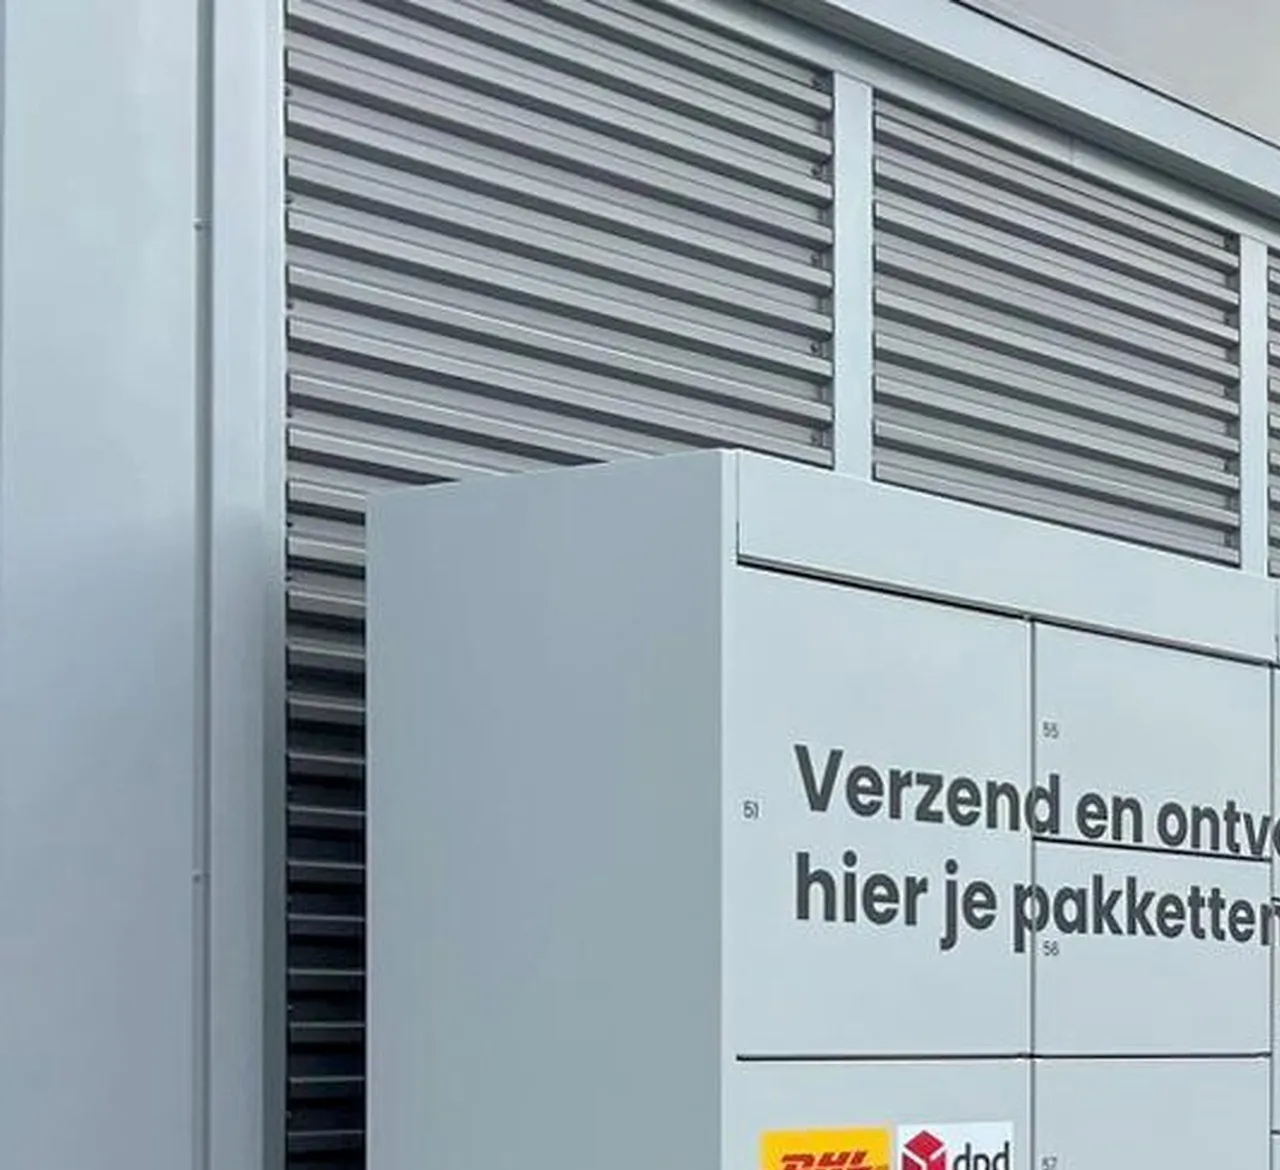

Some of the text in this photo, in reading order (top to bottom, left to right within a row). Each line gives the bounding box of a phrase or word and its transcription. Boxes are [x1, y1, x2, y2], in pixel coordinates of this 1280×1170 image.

[793, 743, 1061, 835] Verzend
[1075, 790, 1143, 844] en
[795, 851, 928, 928] hier
[940, 858, 997, 951] je
